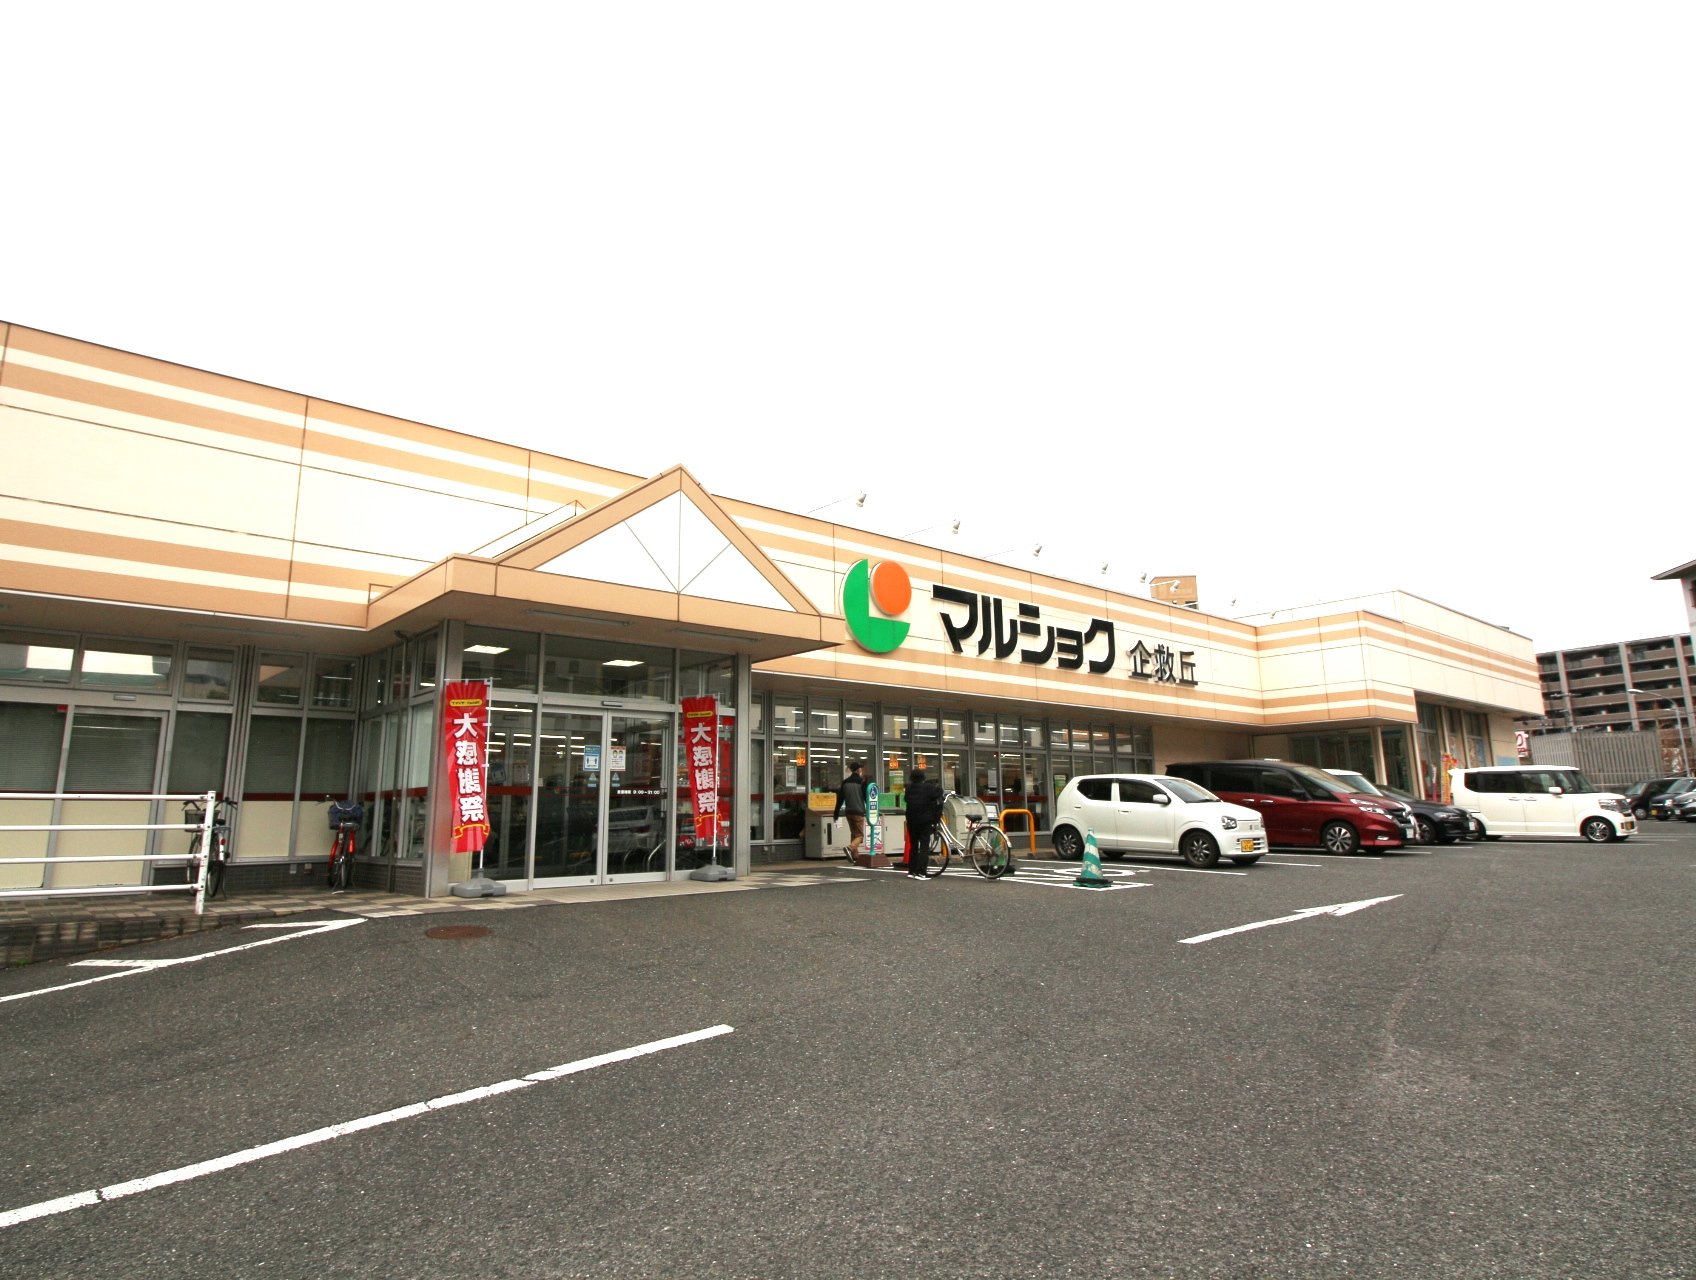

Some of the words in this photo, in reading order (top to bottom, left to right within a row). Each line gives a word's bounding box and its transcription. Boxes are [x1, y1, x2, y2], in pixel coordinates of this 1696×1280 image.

[931, 584, 1115, 674] マルショク
[1128, 639, 1199, 687] 企救丘
